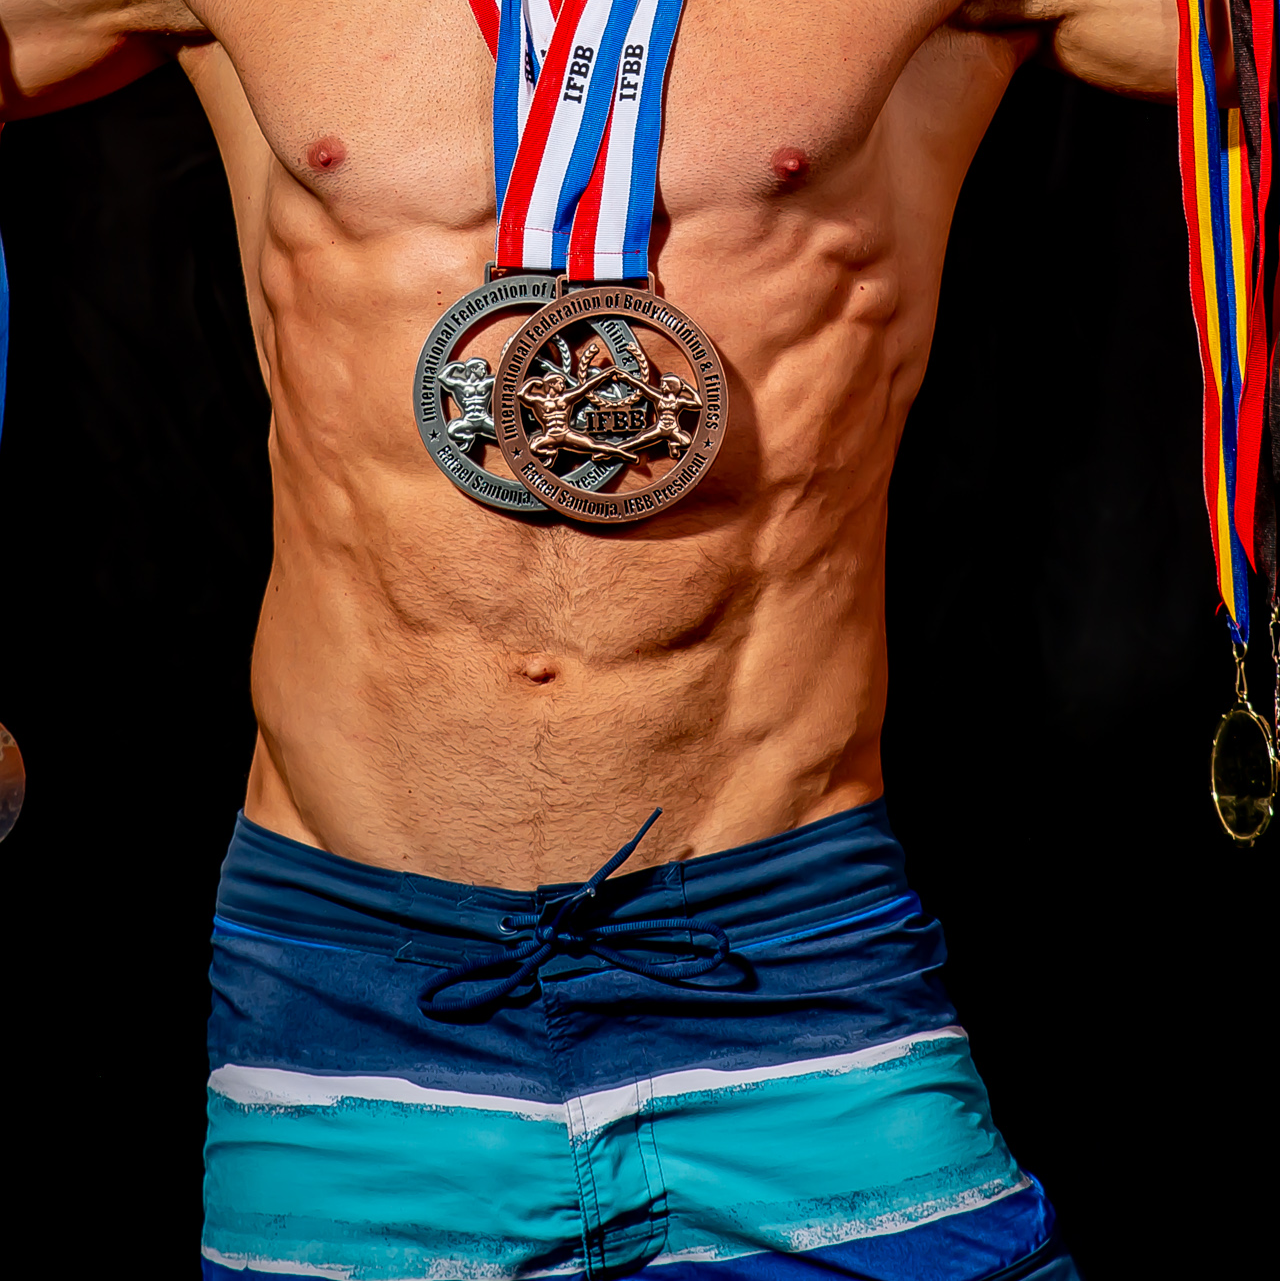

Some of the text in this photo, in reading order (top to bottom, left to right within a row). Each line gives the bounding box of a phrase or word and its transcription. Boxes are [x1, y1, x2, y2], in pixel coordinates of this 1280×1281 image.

[563, 45, 594, 104] IFBB
[619, 44, 644, 101] IFBB
[525, 294, 601, 344] Federation
[605, 293, 621, 309] of
[623, 294, 708, 361] Bodybuilding
[420, 282, 548, 423] International Federation of
[700, 361, 713, 373] &
[500, 338, 534, 441] International
[704, 373, 721, 430] Fitness
[585, 409, 647, 432] IFBB
[436, 444, 475, 485] Rafael
[520, 461, 562, 501] Rafael
[623, 493, 655, 517] IFBB
[652, 451, 710, 506] President
